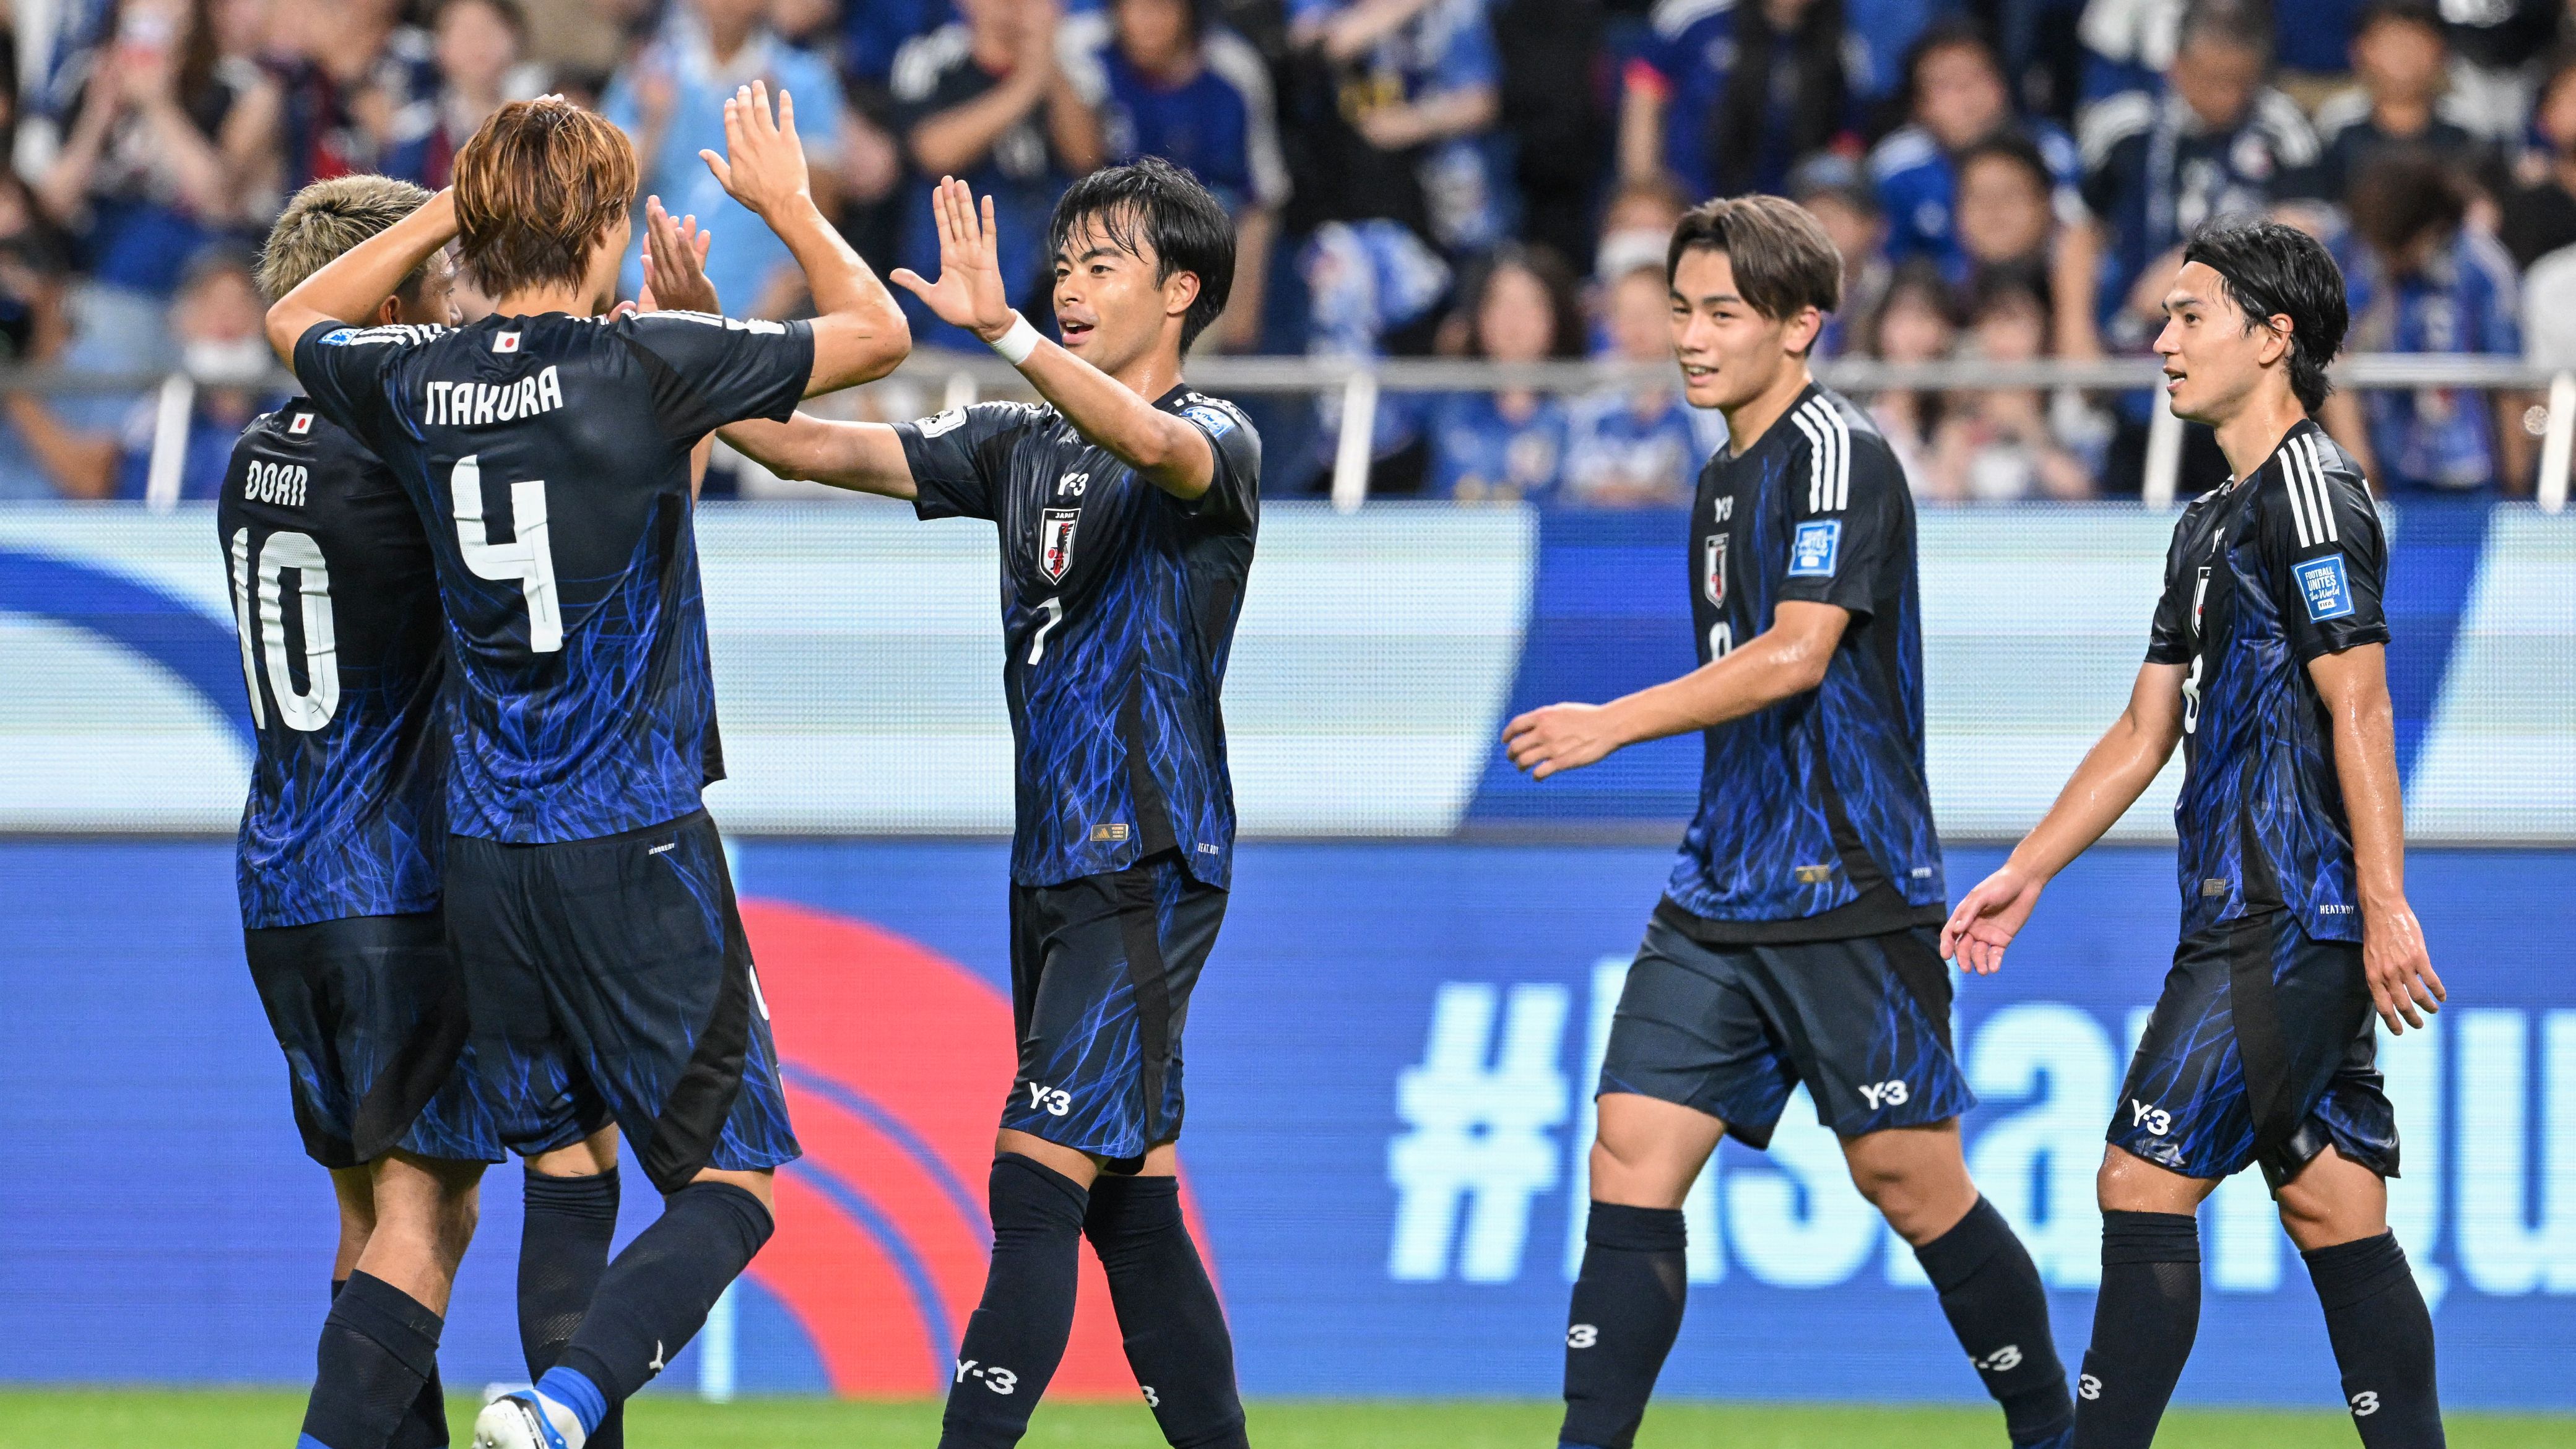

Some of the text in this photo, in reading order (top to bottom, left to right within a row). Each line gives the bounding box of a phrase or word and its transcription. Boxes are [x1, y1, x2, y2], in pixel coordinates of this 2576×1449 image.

[425, 365, 563, 425] ITAKURA
[245, 460, 308, 506] DOAN
[1057, 472, 1090, 496] Y-3
[450, 454, 563, 653] 4
[1050, 559, 1064, 571] JFA
[2304, 566, 2335, 581] FOOTBALL
[2307, 574, 2337, 592] UNITES
[2309, 585, 2340, 602] the World
[231, 527, 340, 732] 10
[1028, 596, 1062, 665] 7
[2320, 904, 2354, 914] HEAT.RDY
[1030, 1081, 1071, 1116] Y-3
[1858, 1079, 1909, 1110] Y-3
[2131, 1099, 2171, 1136] Y-3
[956, 1359, 1018, 1395] Y-3
